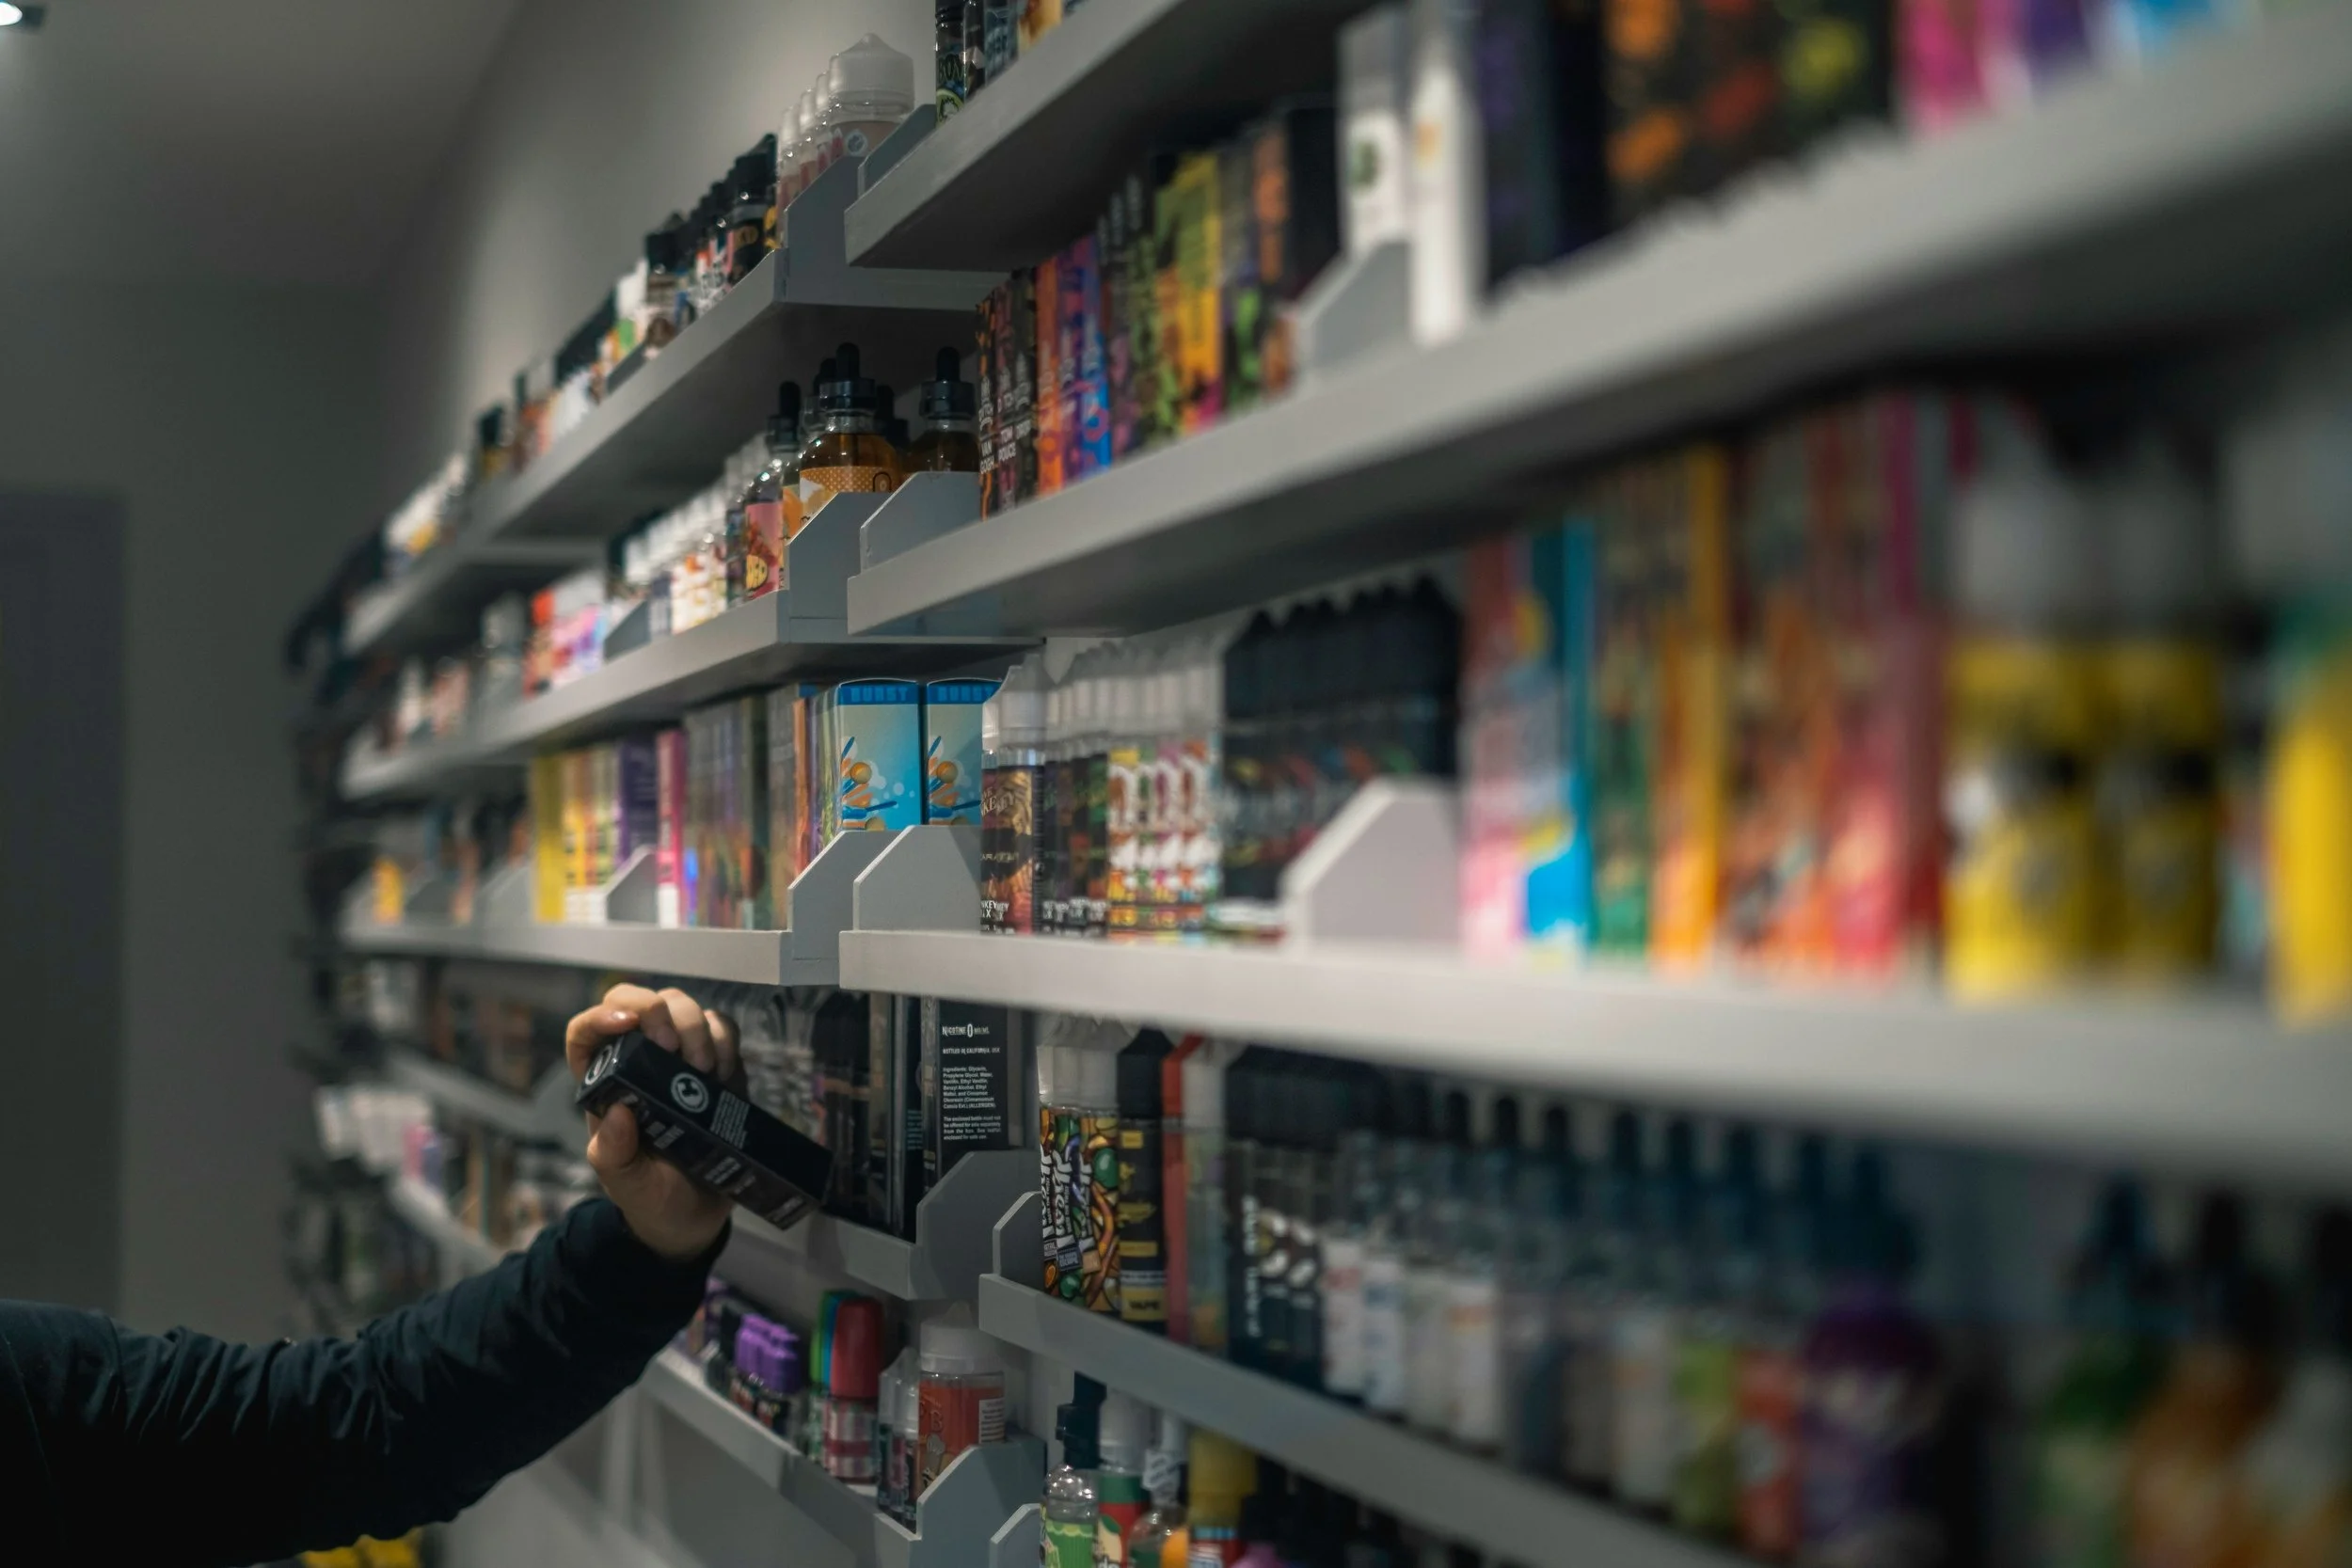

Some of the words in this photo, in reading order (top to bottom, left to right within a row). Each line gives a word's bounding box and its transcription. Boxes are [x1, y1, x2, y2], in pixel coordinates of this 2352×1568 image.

[981, 439, 993, 456] VAN
[980, 455, 994, 474] GOGH
[942, 1026, 966, 1037] NICOTINE
